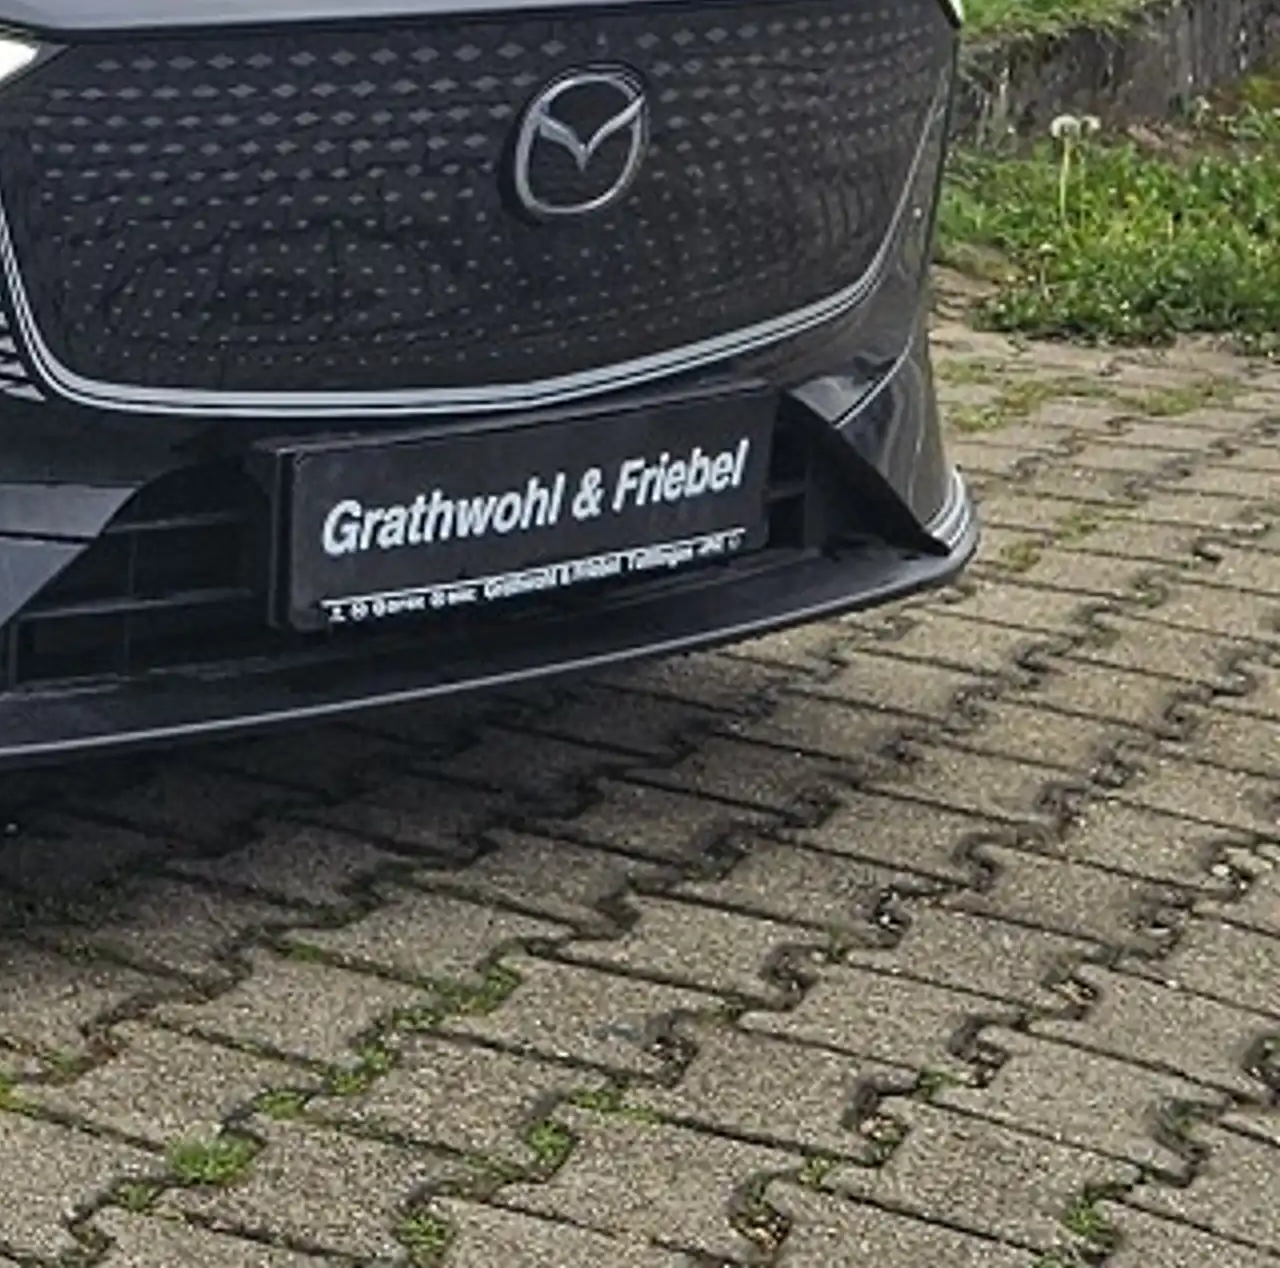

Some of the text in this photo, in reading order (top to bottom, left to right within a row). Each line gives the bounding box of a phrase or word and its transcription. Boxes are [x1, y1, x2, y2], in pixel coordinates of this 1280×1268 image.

[322, 438, 749, 556] Grathwohl & Friebel
